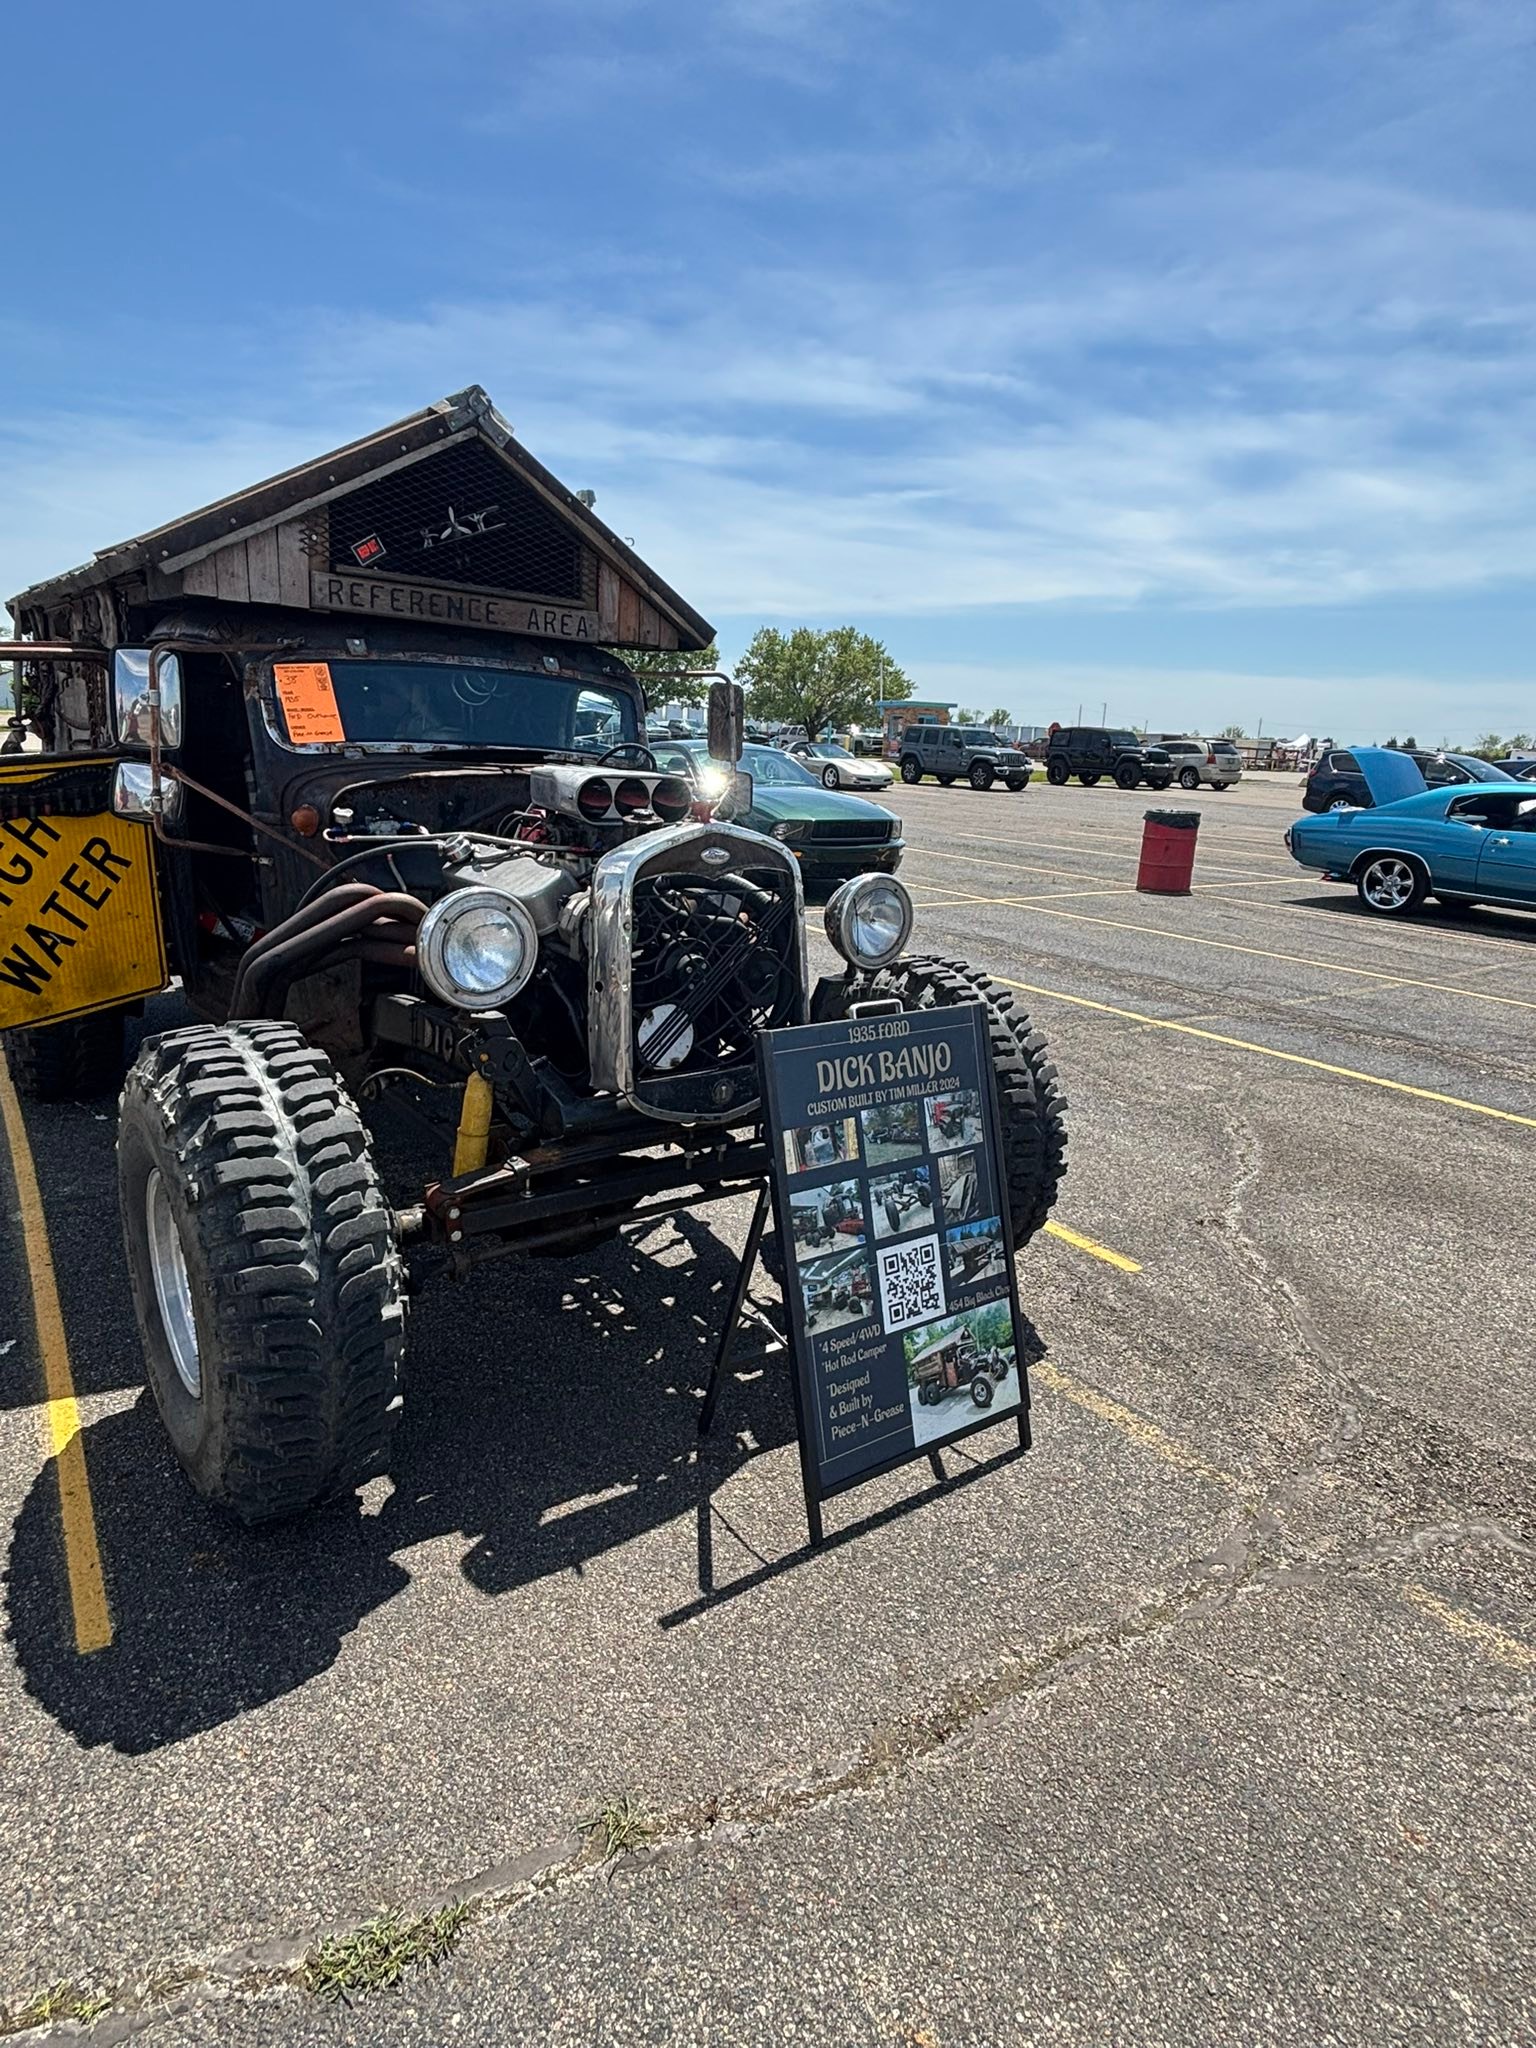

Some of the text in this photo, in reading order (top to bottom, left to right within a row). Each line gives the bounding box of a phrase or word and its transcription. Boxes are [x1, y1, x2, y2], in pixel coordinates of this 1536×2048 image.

[328, 579, 588, 638] REFERENCE AREA
[0, 816, 62, 907] GH
[0, 836, 133, 996] WATER
[424, 1018, 457, 1063] DIC
[848, 1019, 910, 1044] 1935 FORD
[816, 1041, 952, 1093] DICK BANJO
[807, 1076, 961, 1116] CUSTOM BUILT BY TIM MILLER 2024
[830, 1324, 881, 1352] Speed/4WD
[840, 1352, 857, 1368] Rod
[857, 1343, 888, 1362] Camper
[829, 1391, 874, 1419] & Built by
[831, 1402, 905, 1441] Piece-N-Grease
